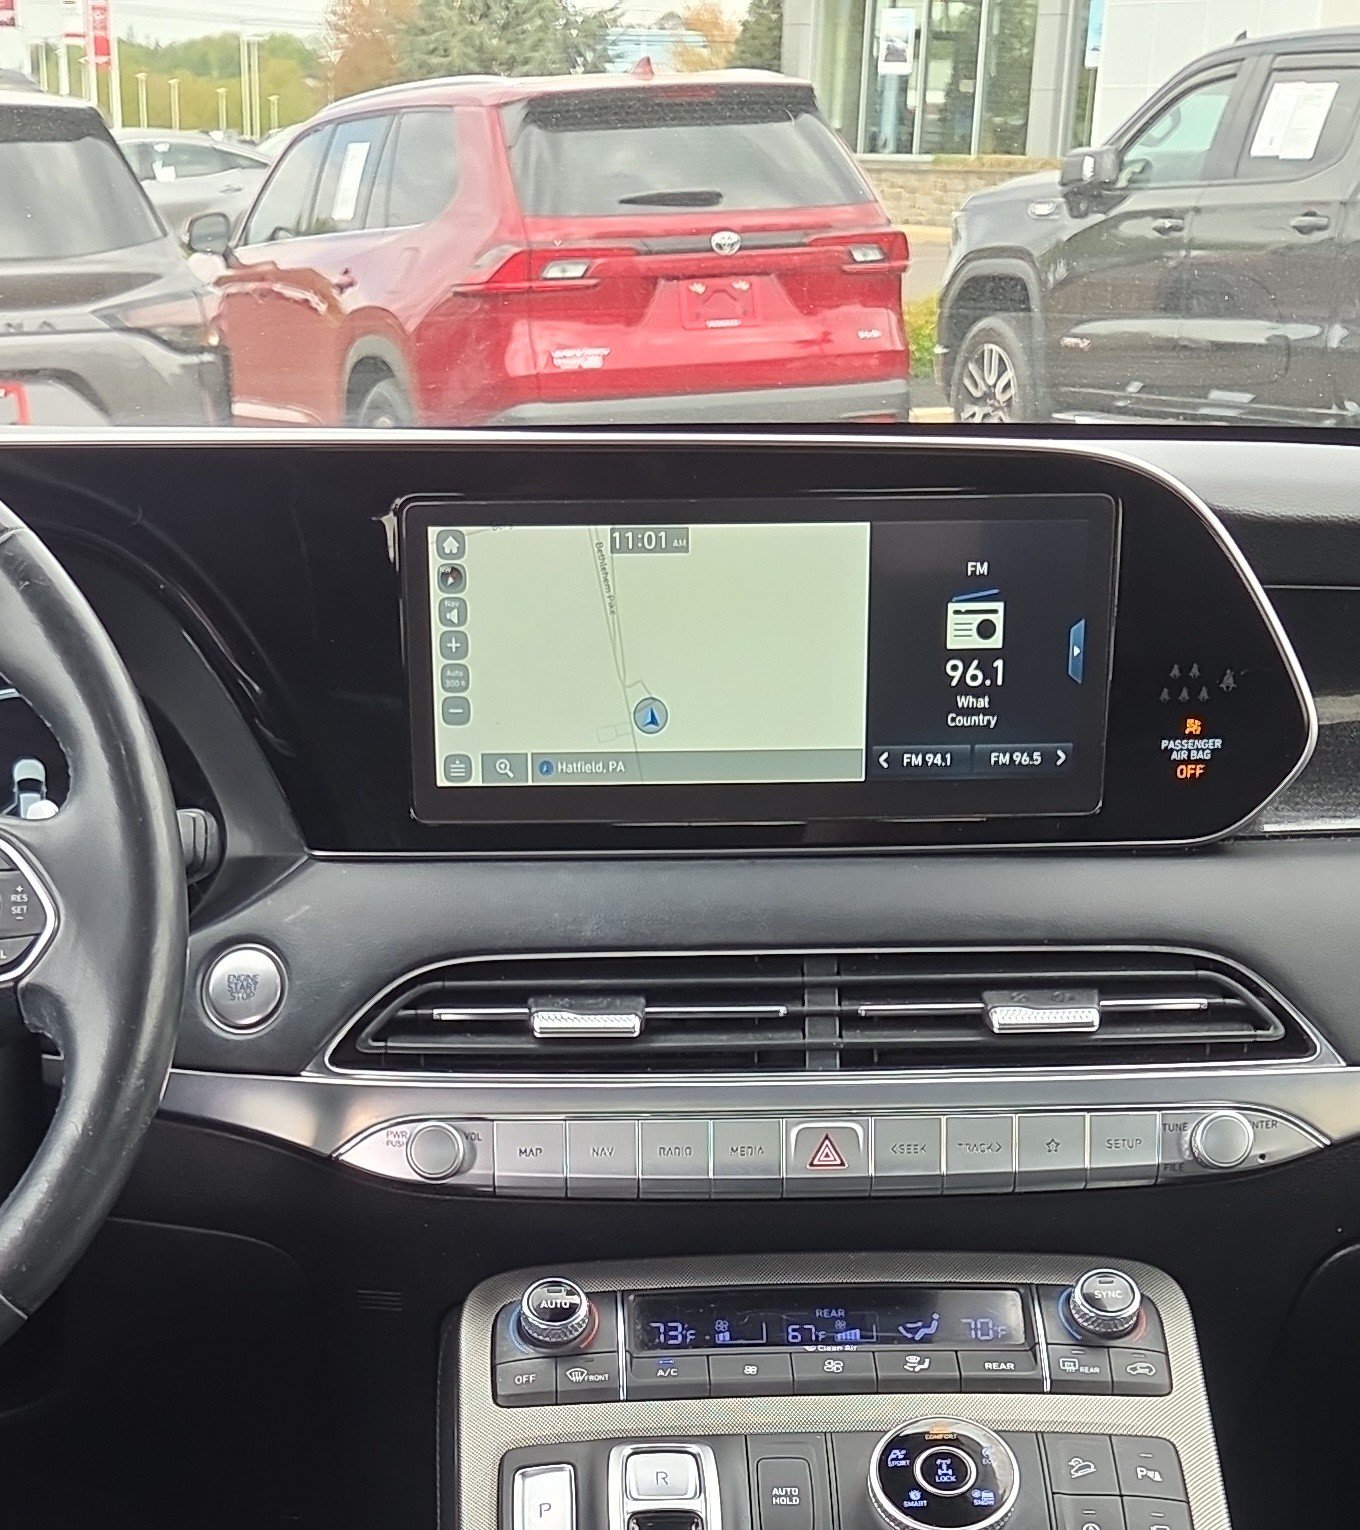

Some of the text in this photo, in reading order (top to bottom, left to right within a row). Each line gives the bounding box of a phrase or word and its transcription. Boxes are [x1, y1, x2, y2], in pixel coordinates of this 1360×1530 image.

[612, 531, 687, 550] 11:01 AM
[595, 541, 614, 597] Bethlehem
[967, 562, 989, 576] FM
[945, 658, 1004, 687] 96.1
[957, 695, 990, 709] What
[947, 713, 998, 728] Country
[1161, 739, 1223, 750] PASSENGER
[903, 753, 952, 767] FM 94.1
[990, 752, 1042, 766] FM 96.5
[1171, 750, 1211, 760] AIR BAG
[558, 760, 626, 774] Hatfield, PA
[1176, 765, 1206, 779] OFF
[11, 894, 28, 903] RES
[11, 905, 28, 915] SET
[228, 981, 259, 992] START
[1163, 1122, 1189, 1132] TUNE
[1250, 1120, 1279, 1130] NTER
[464, 1132, 482, 1142] VOL
[1106, 1138, 1142, 1150] SETUP
[519, 1147, 543, 1158] MAP
[592, 1147, 615, 1157] NAV
[658, 1146, 693, 1157] RADIO
[730, 1145, 764, 1156] MEDIA
[1163, 1163, 1186, 1173] FILE
[1094, 1290, 1123, 1299] SYNC
[540, 1299, 570, 1309] AUTO
[815, 1308, 846, 1318] REAR
[984, 1362, 1015, 1371] REAR
[1079, 1366, 1100, 1374] REAR
[657, 1368, 678, 1377] A/C
[514, 1374, 536, 1385] OFF
[585, 1374, 609, 1382] FRONT
[655, 1471, 669, 1486] R
[935, 1475, 956, 1483] LOCK
[772, 1487, 799, 1497] AUTO
[772, 1497, 800, 1506] HOLD
[904, 1500, 927, 1508] SMART
[539, 1503, 551, 1518] P
